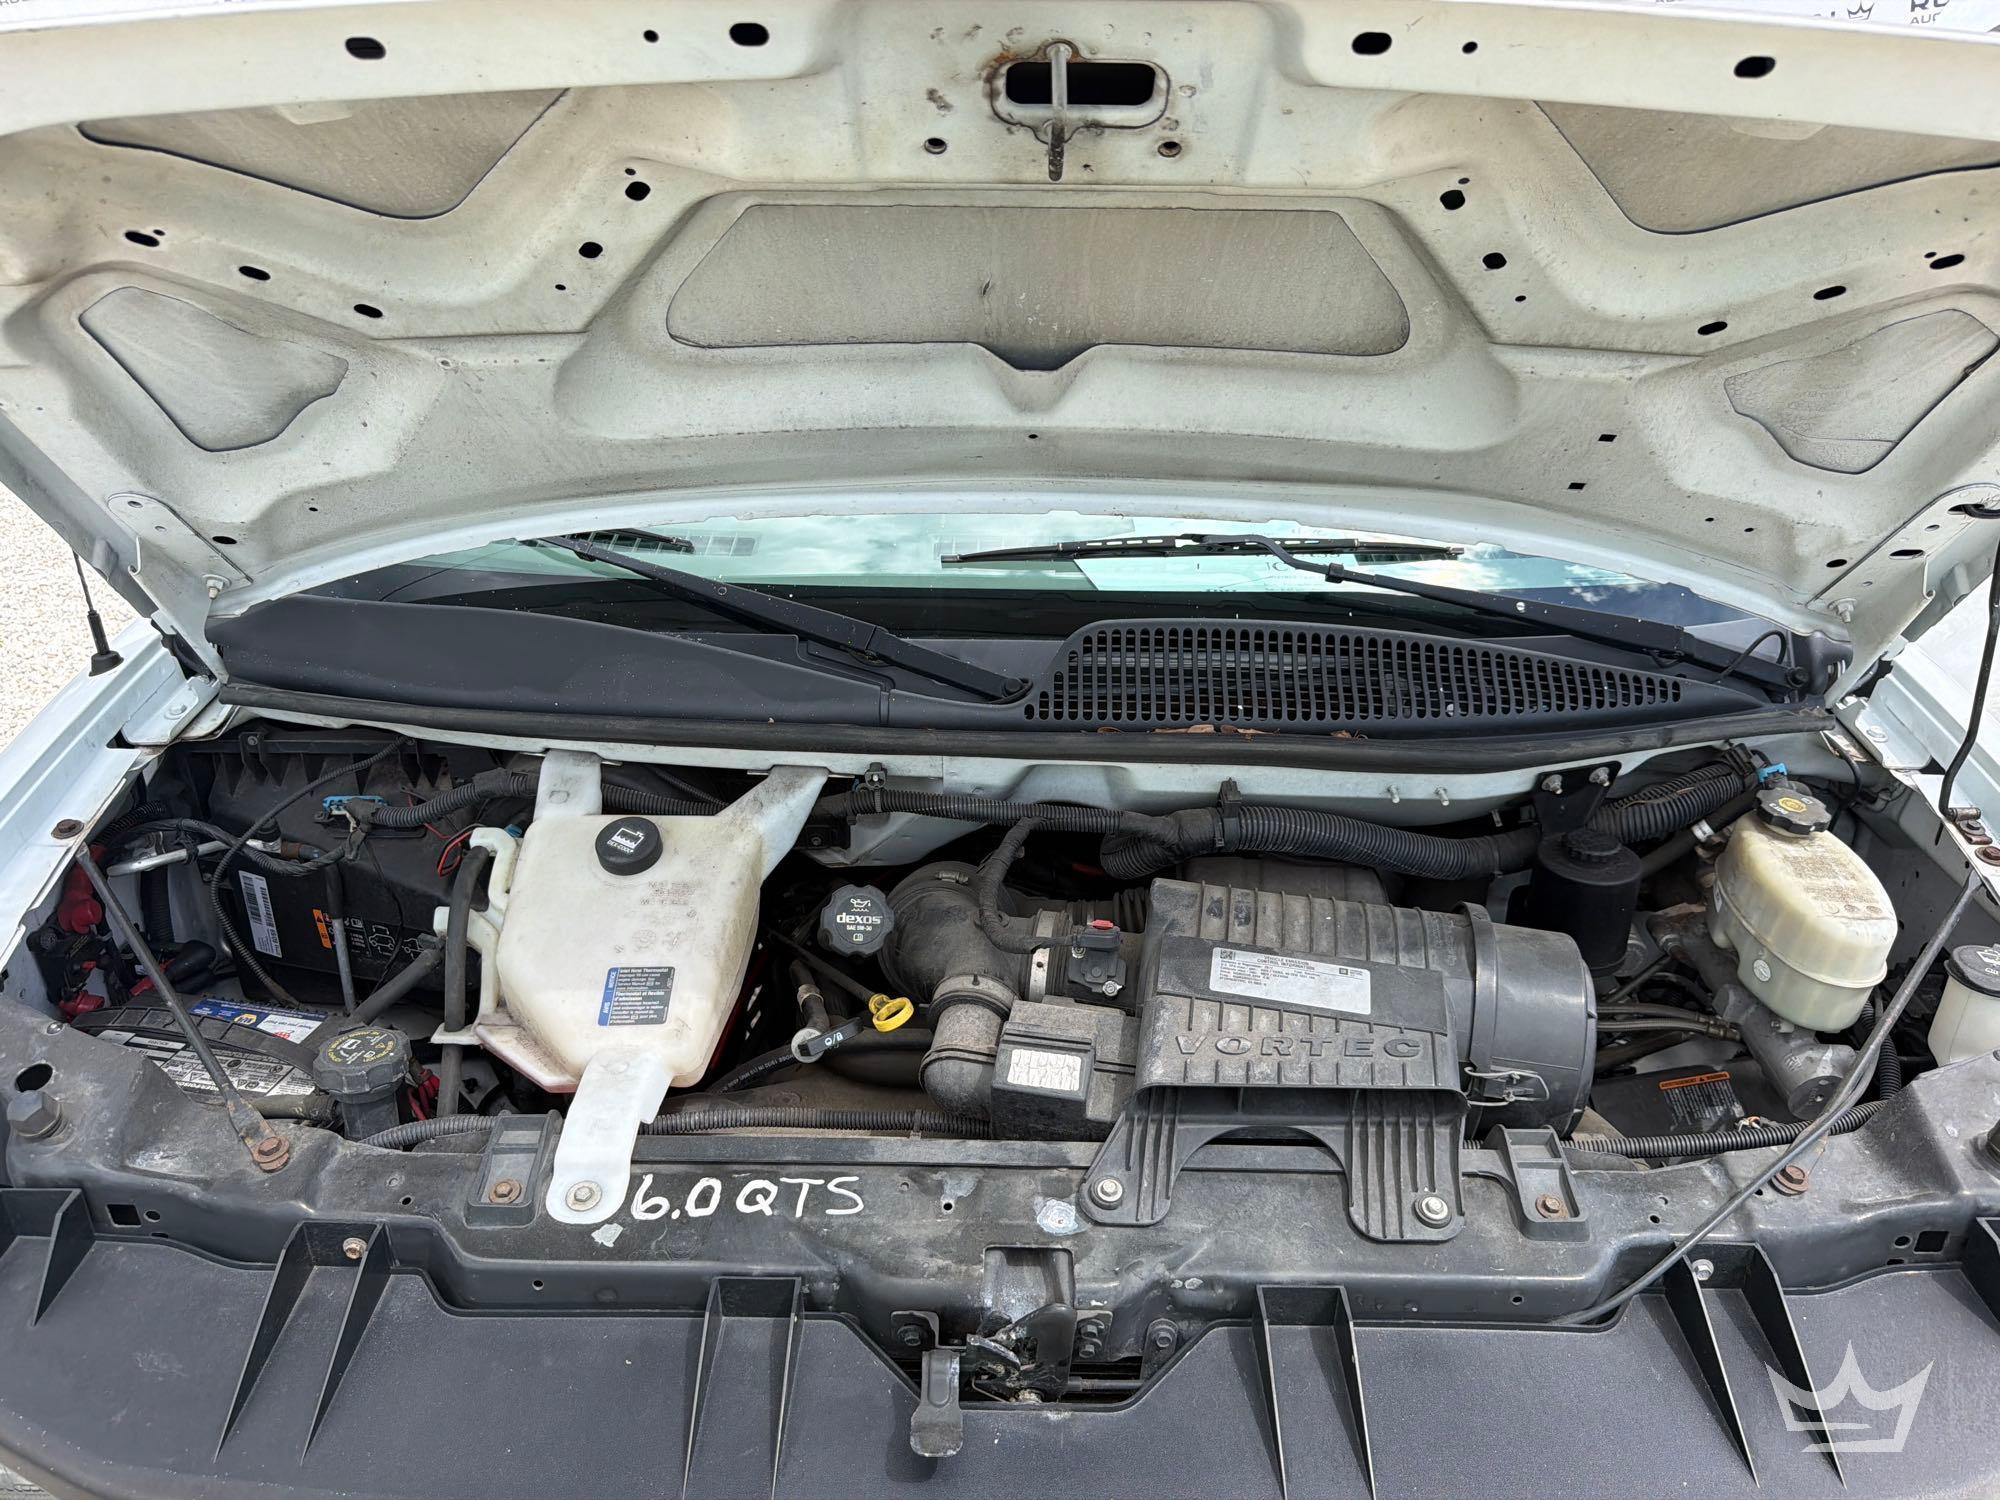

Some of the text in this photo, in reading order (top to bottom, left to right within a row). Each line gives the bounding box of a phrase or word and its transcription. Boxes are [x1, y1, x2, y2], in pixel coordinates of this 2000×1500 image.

[836, 912, 883, 925] dexos
[1175, 1034, 1421, 1058] VORTEC
[630, 1173, 865, 1221] 6.0 QTS
